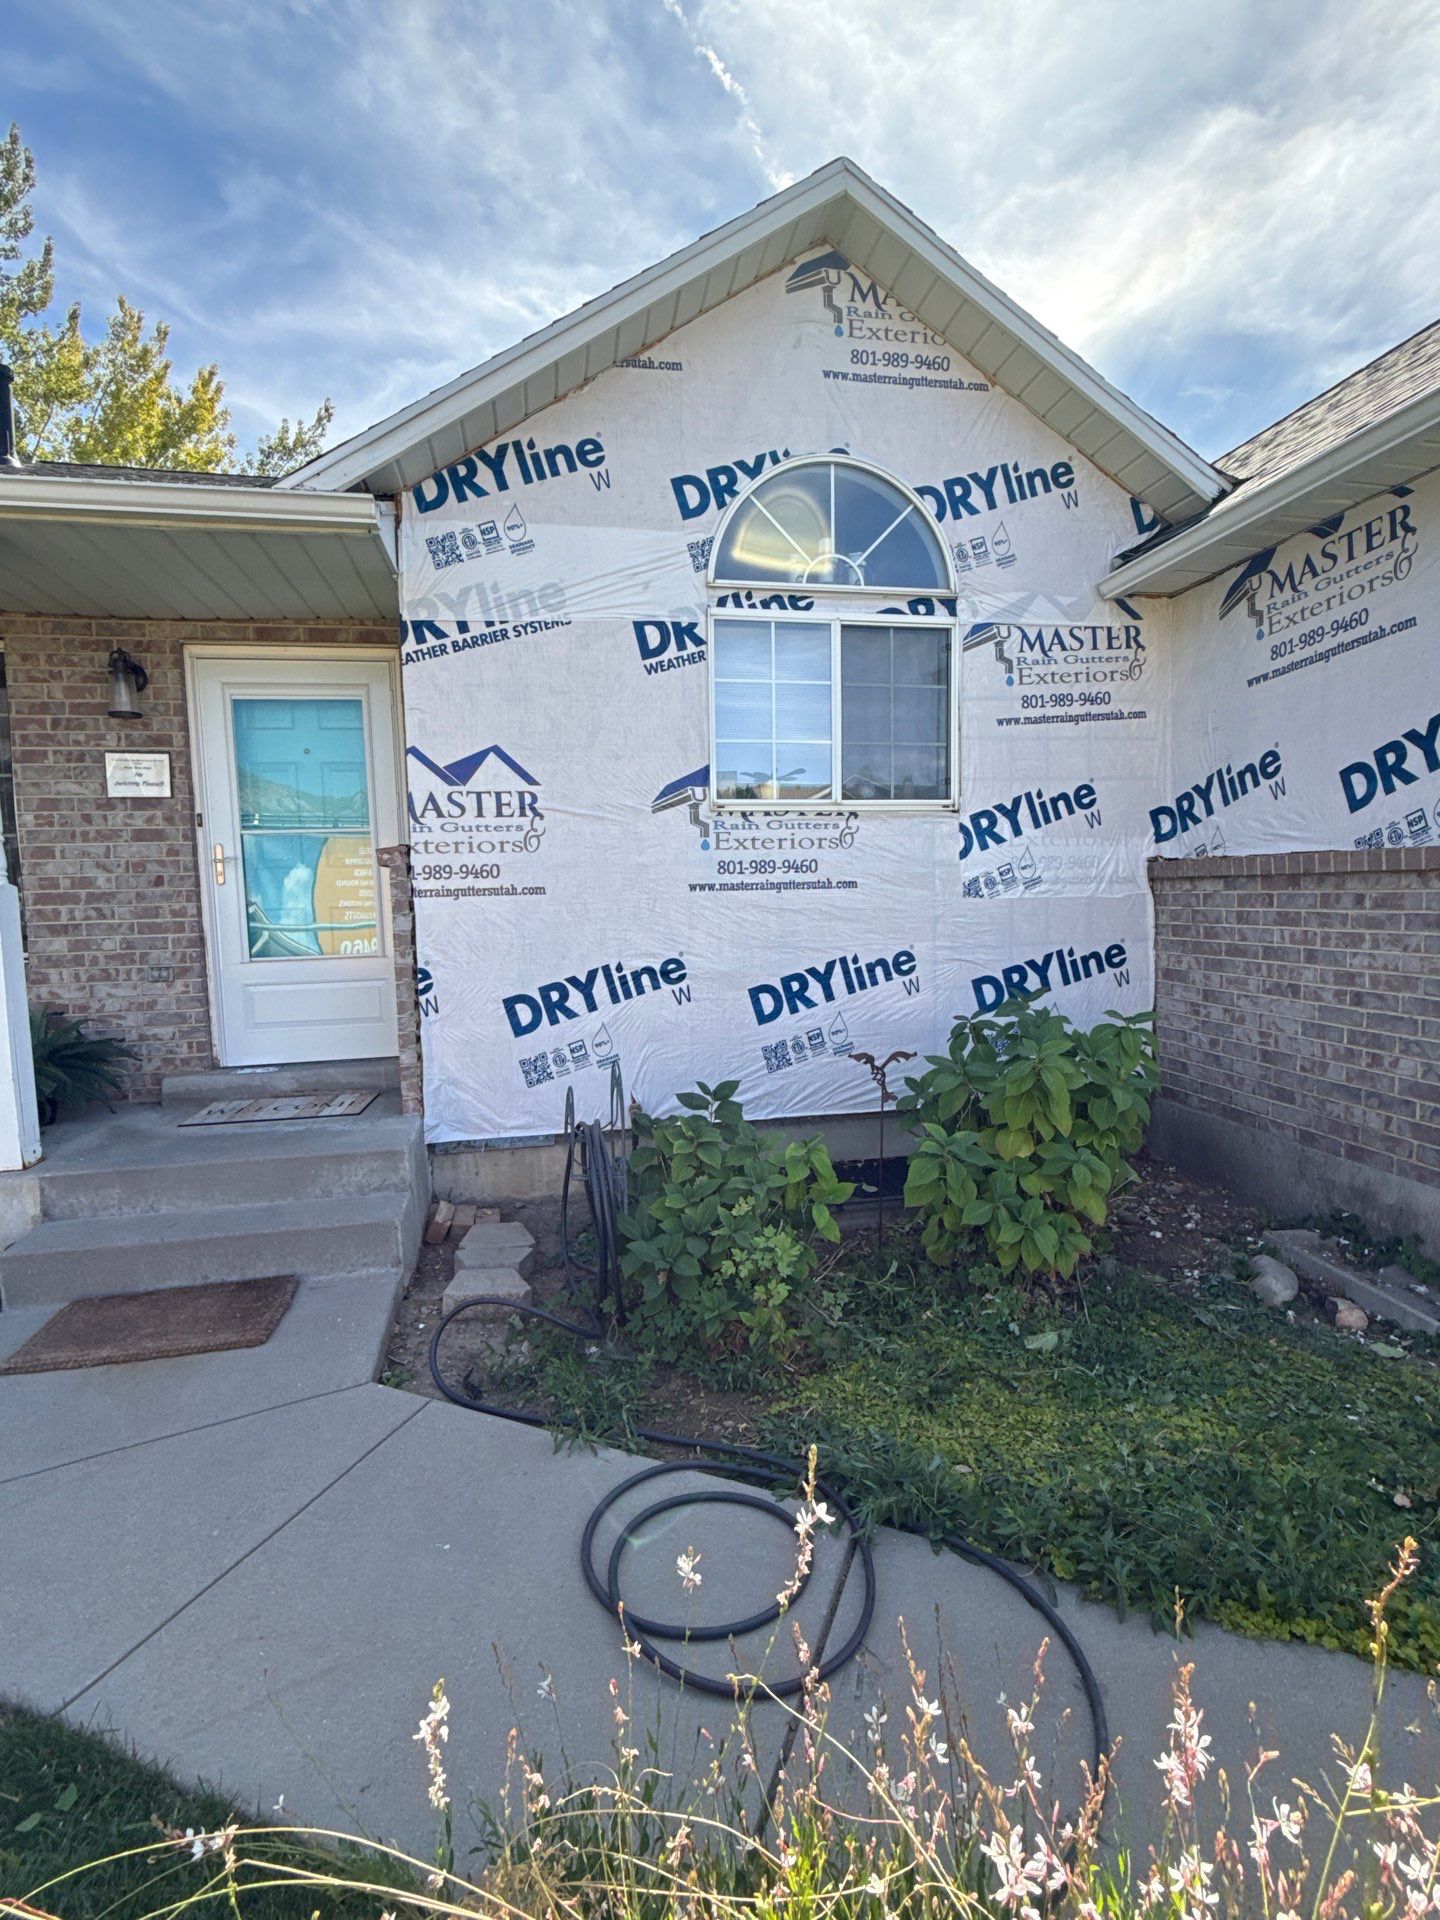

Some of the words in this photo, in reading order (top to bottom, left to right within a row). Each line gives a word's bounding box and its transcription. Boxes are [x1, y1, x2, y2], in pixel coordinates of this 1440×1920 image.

[845, 305, 893, 320] Rain
[850, 349, 951, 371] 801-989-9460
[823, 369, 989, 392] www.masterrainguttersutah.com
[412, 436, 606, 514] DRYline
[589, 468, 611, 492] W
[1061, 490, 1080, 510] W
[1266, 504, 1418, 599] MASTER
[1266, 588, 1311, 614] Rain
[1314, 549, 1395, 592] Gutters
[1266, 568, 1395, 637] Exteriors
[450, 628, 509, 653] BARRIER
[513, 613, 573, 639] SYSTEMS
[1013, 625, 1147, 658] MASTER
[1270, 607, 1370, 661] 801-989-9460
[1015, 653, 1059, 666] Rain
[1064, 654, 1130, 665] Gutters
[1247, 614, 1418, 688] www.masterrainguttersutah.com
[644, 650, 707, 676] WEATHER
[1017, 666, 1130, 686] Exteriors
[1021, 691, 1112, 709] 801-989-9460
[997, 709, 1147, 727] www.masterrainguttersutah.com
[1148, 748, 1282, 844] DRYline
[1268, 776, 1287, 801] W
[440, 822, 525, 833] Gutters
[712, 819, 760, 830] Rain
[766, 819, 840, 830] Gutters
[1084, 809, 1102, 829] W
[713, 830, 840, 851] Exteriors
[717, 858, 819, 875] 801-989-9460
[689, 877, 859, 894] www.masterrainguttersutah.com
[748, 949, 917, 1026] DRYline
[902, 976, 920, 996] W
[972, 943, 1128, 1014] DRYline
[1113, 968, 1131, 988] W
[502, 957, 687, 1038] DRYline
[672, 985, 692, 1006] W
